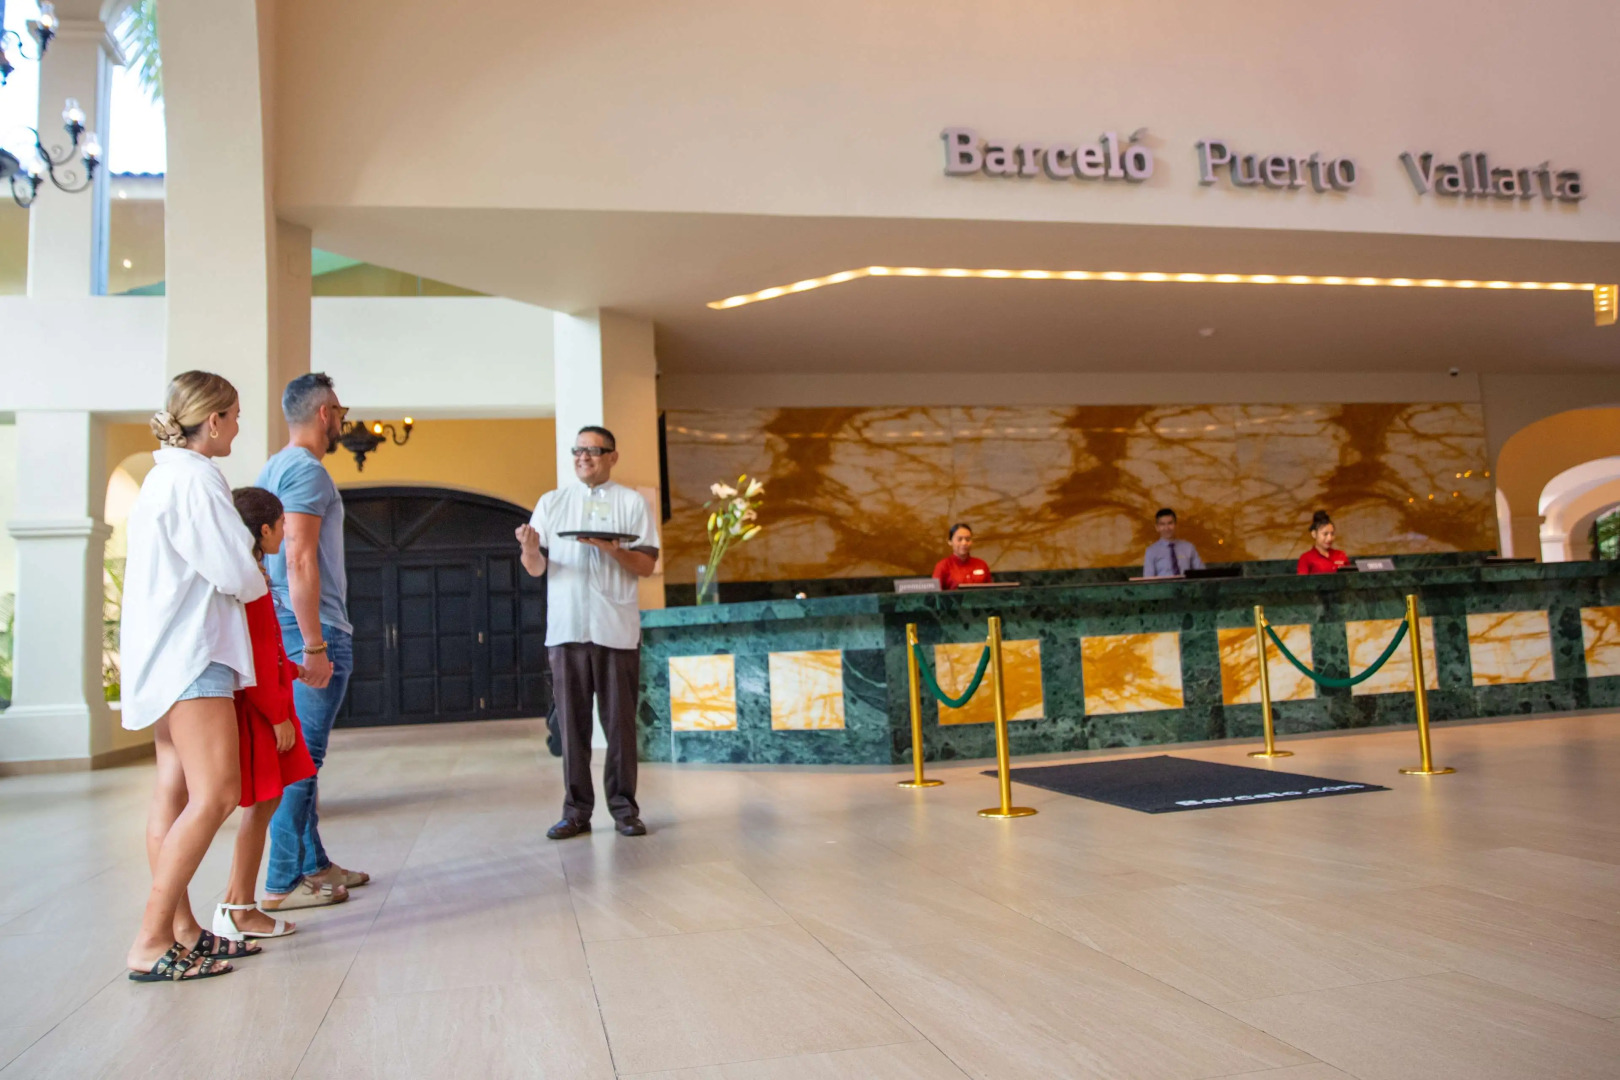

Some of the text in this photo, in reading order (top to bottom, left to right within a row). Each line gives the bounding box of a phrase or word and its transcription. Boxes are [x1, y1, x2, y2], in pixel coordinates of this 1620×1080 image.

[940, 127, 1586, 203] Barceló Puerto Vallarta
